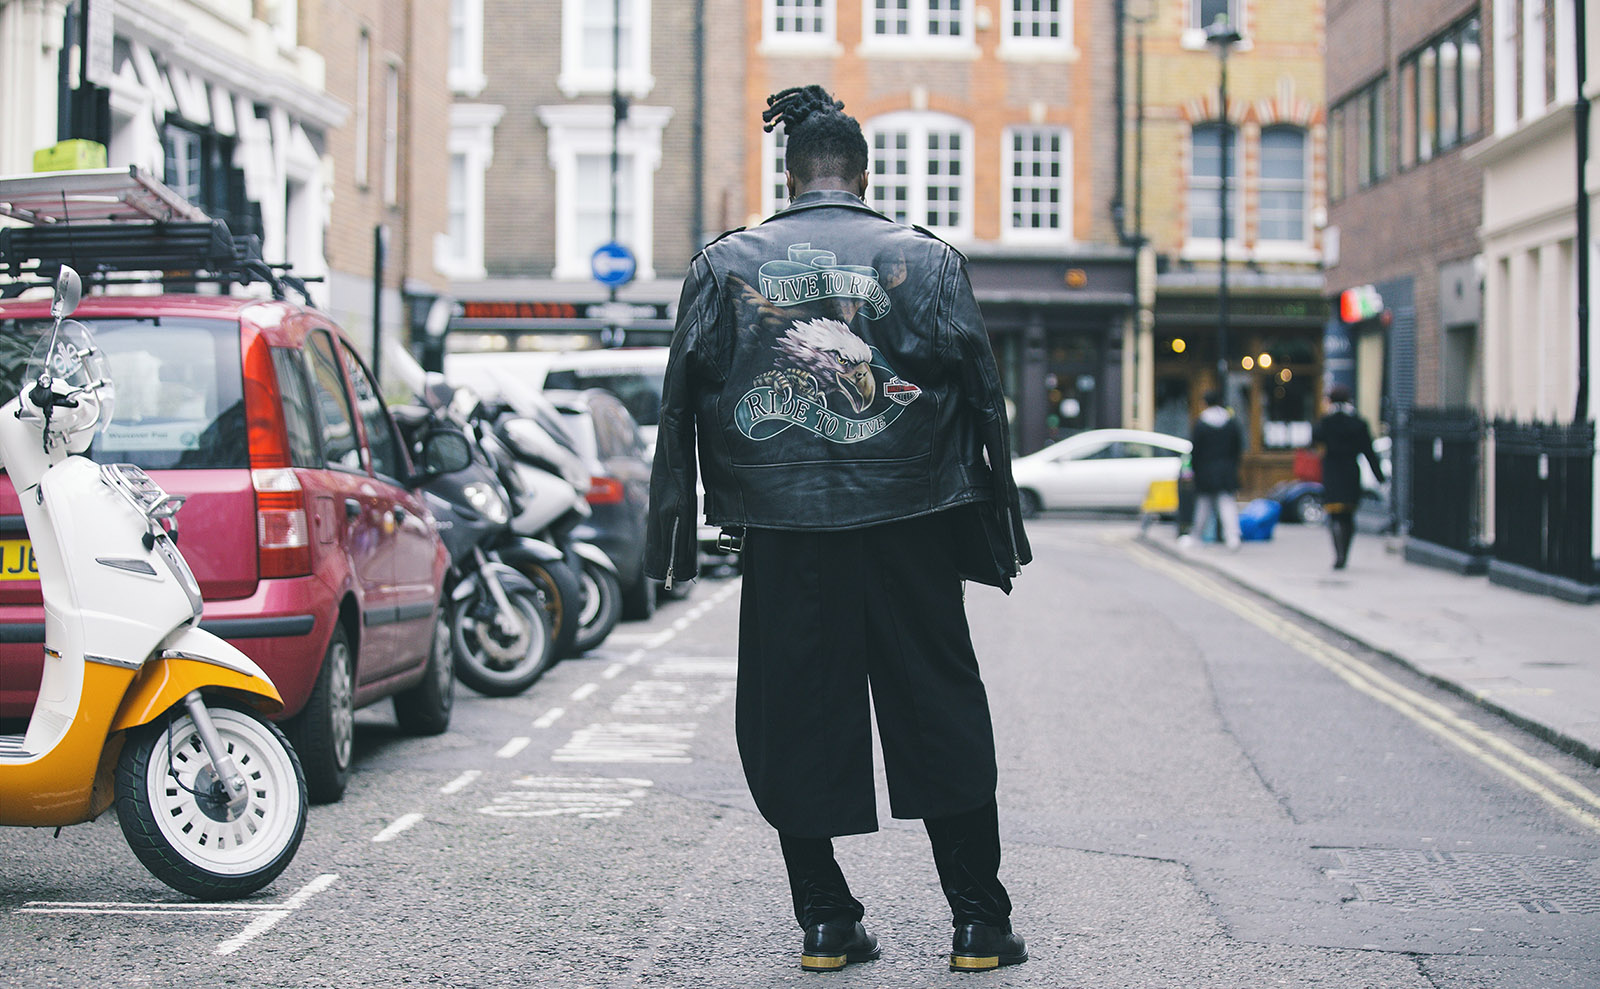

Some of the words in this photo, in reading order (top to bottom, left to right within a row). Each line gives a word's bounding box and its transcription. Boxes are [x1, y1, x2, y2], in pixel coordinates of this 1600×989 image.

[762, 273, 819, 303] LIVE
[821, 271, 844, 294] TO
[847, 275, 890, 315] RIDE
[745, 389, 810, 424] RIDE
[815, 409, 839, 437] TO
[843, 415, 887, 441] LIVE
